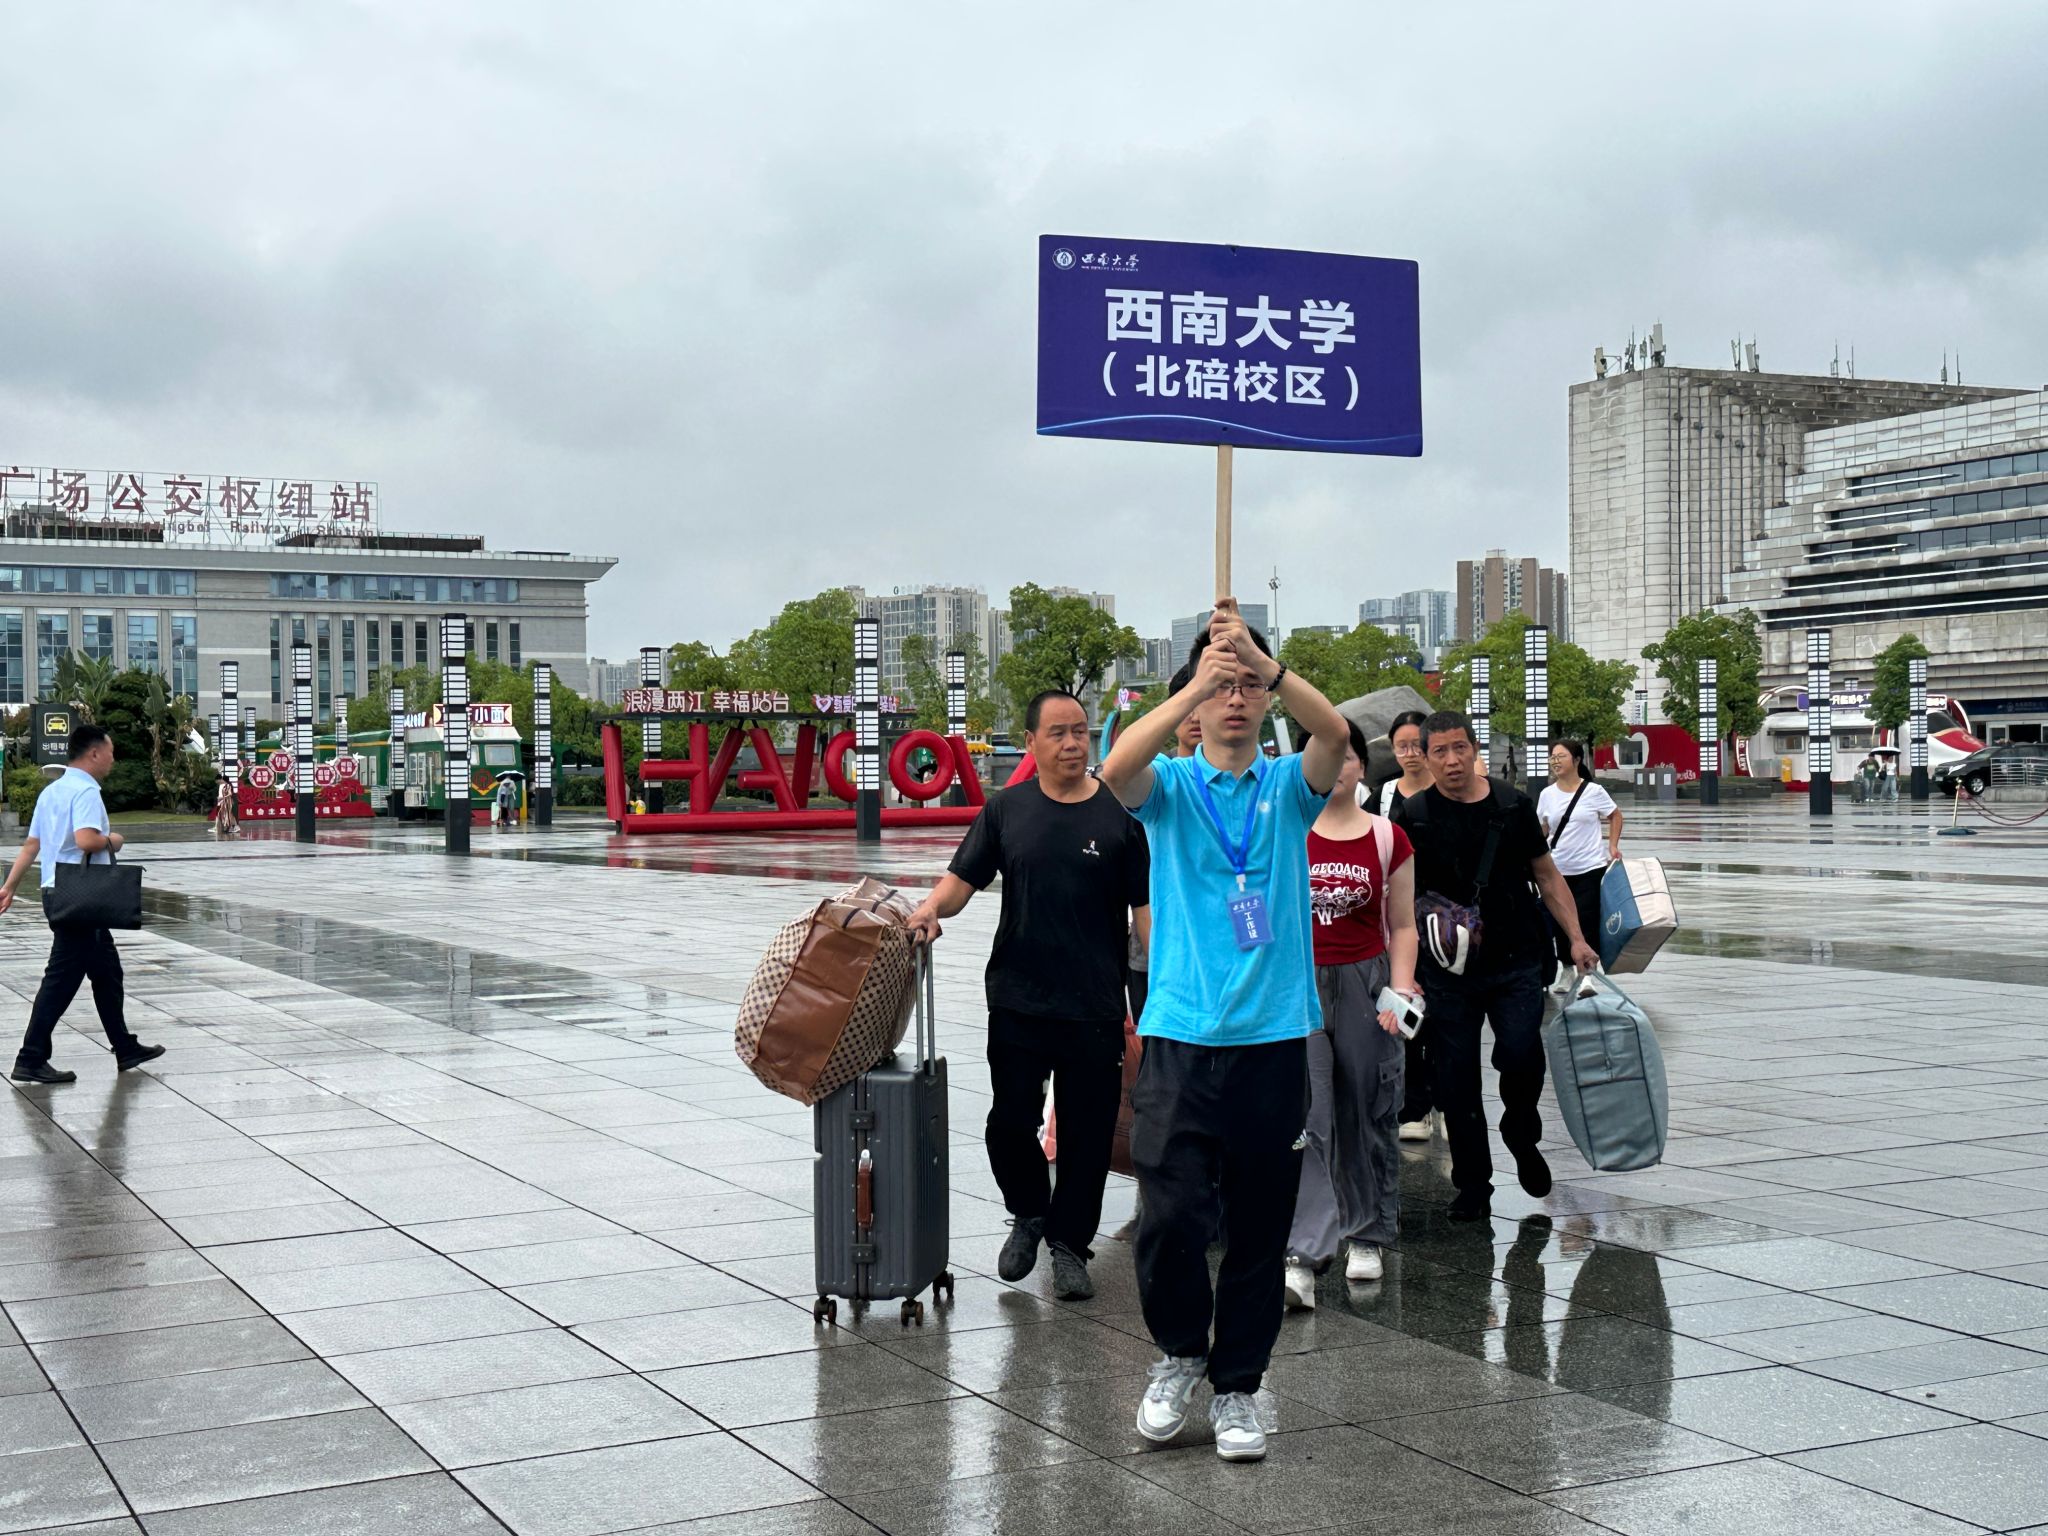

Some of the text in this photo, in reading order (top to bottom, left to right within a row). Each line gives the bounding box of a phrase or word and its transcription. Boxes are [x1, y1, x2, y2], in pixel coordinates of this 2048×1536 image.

[1104, 287, 1357, 355] 西南大学
[625, 690, 790, 713] 浪漫两江 幸福站台
